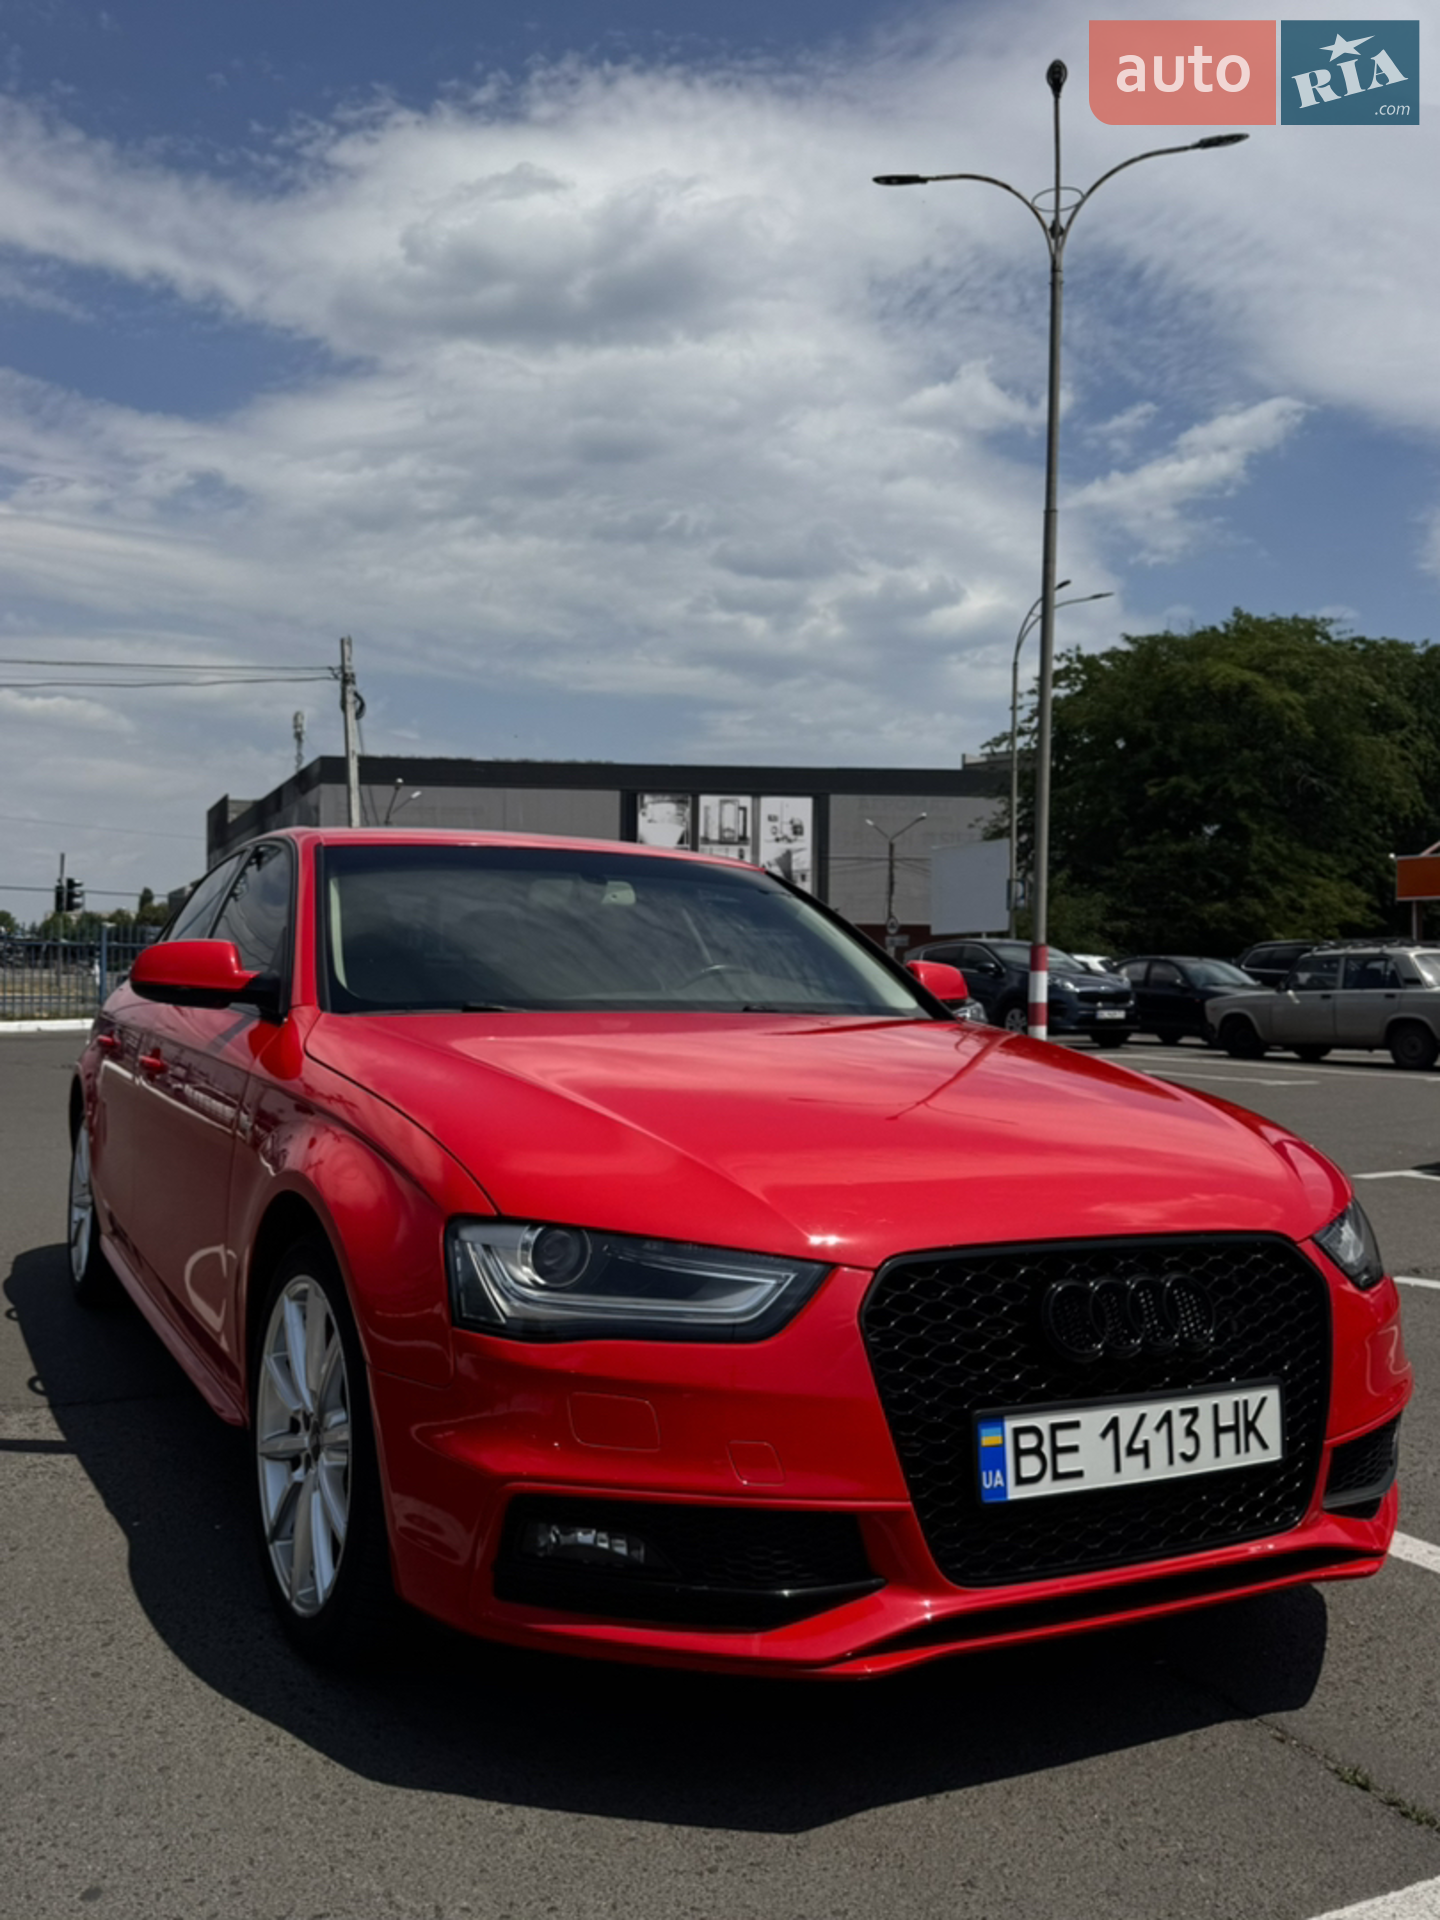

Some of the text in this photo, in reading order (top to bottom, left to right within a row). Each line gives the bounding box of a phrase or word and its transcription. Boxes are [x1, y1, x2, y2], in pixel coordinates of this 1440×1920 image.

[1011, 1396, 1270, 1486] BE 1413 HK
[982, 1470, 1004, 1490] UA
